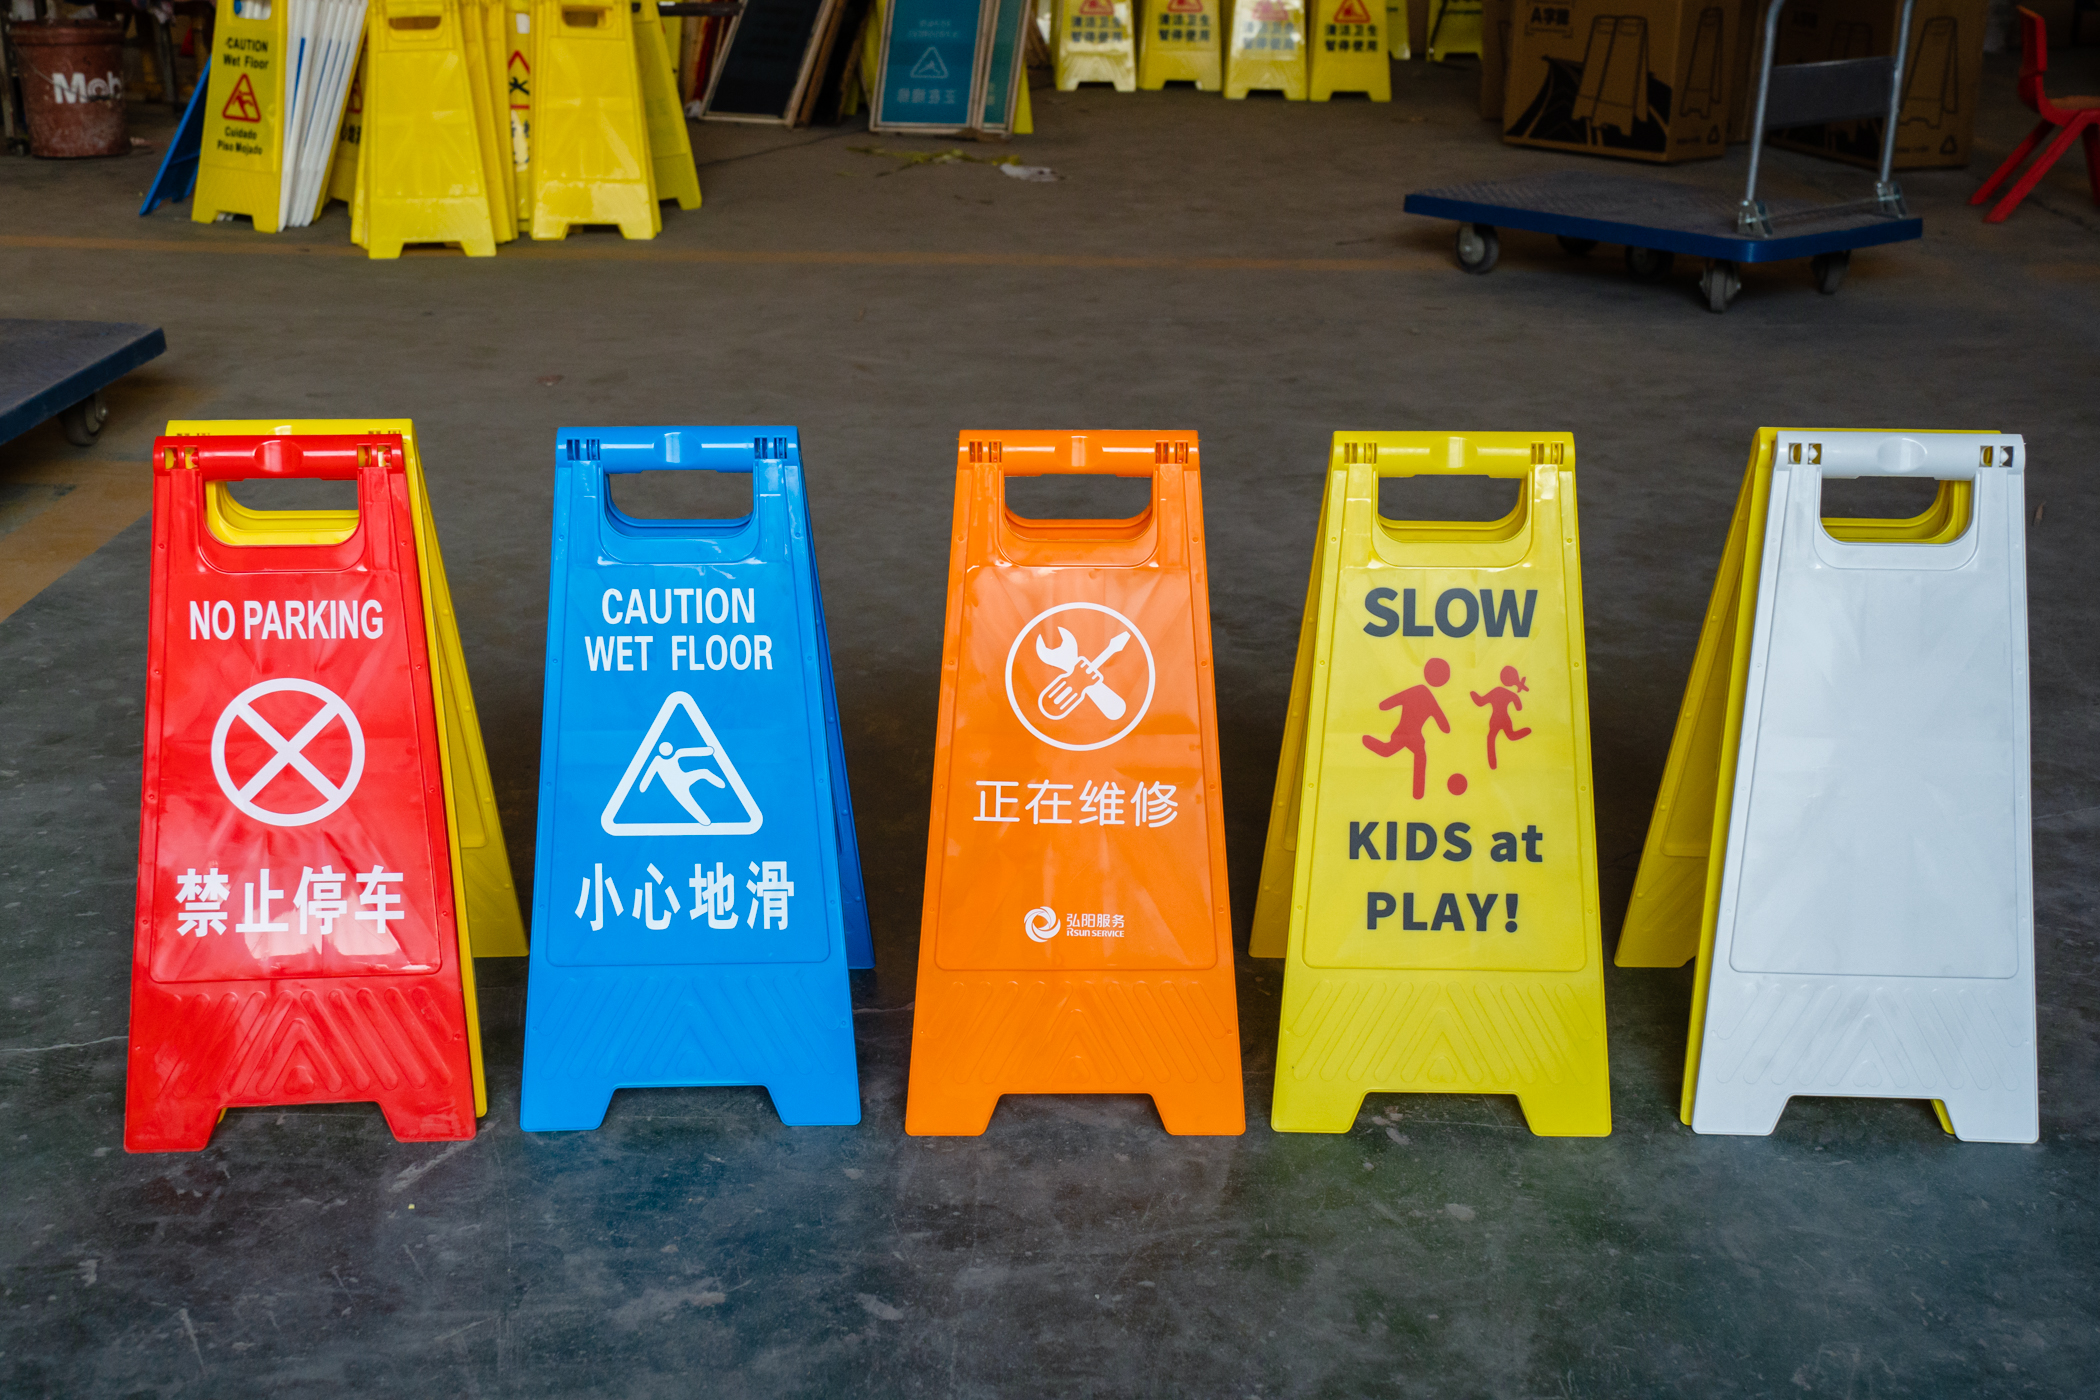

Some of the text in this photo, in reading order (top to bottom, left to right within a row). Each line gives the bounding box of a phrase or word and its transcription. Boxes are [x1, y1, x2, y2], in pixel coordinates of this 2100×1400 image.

[223, 53, 269, 70] Wet Floor
[225, 36, 269, 52] CAUTION
[217, 139, 264, 156] Piso Mojado
[224, 126, 257, 141] Cuidado
[189, 599, 384, 641] NO PARKING
[601, 587, 756, 625] CAUTION
[1362, 587, 1539, 639] SLOW
[584, 634, 774, 672] WET FLOOR
[972, 778, 1179, 829] 正在维修
[1349, 821, 1544, 863] KIDS at
[174, 864, 406, 938] 禁止停车
[574, 860, 795, 932] 小心地滑
[1366, 891, 1519, 934] PLAY!
[1066, 913, 1125, 929] 弘阳服务
[1091, 929, 1125, 938] SERVICE
